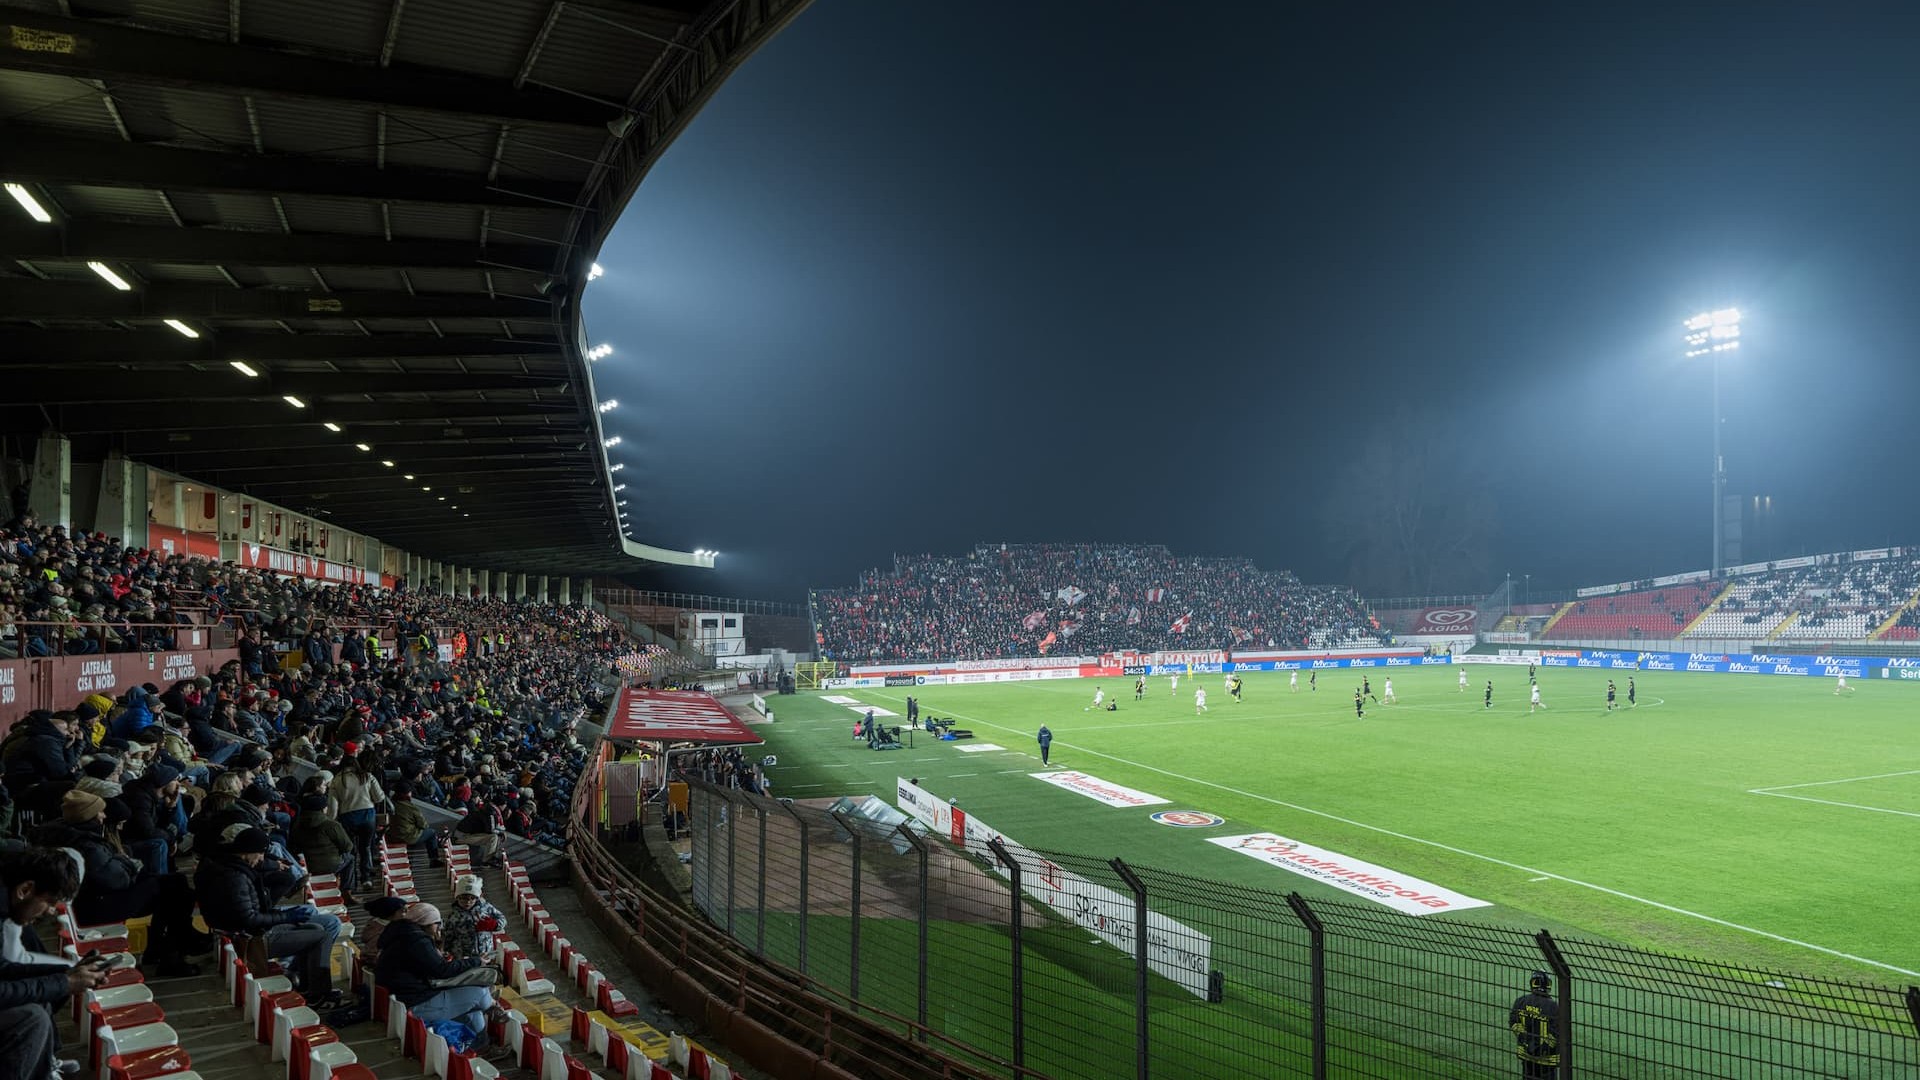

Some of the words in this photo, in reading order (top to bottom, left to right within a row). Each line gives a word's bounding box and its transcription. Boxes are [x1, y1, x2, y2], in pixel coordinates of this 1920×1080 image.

[1417, 624, 1470, 633] ALGIDA
[81, 659, 113, 676] LATERALE
[165, 654, 193, 669] LATERALE
[1100, 655, 1152, 668] ULTRAS
[163, 667, 177, 681] CISA
[178, 665, 196, 679] NORD
[77, 677, 94, 692] CISA
[95, 673, 116, 690] NORD
[2, 687, 16, 703] SUD
[1264, 845, 1451, 908] Ortofrutticola
